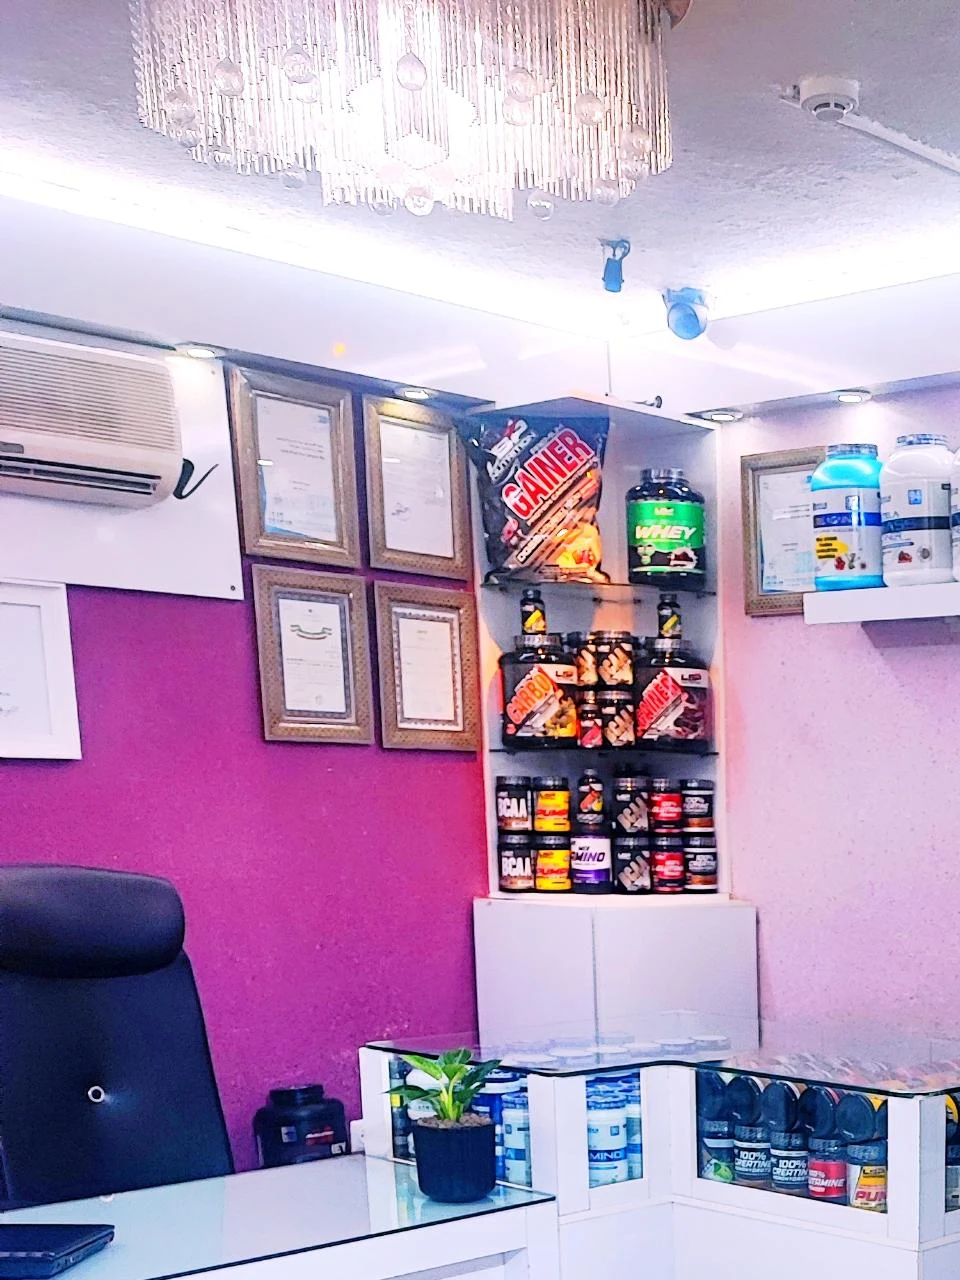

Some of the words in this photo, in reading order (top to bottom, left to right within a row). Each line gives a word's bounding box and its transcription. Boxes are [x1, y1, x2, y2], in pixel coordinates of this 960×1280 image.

[501, 427, 596, 520] GAINER
[635, 525, 697, 540] WHEY
[506, 671, 552, 725] CARBO
[502, 856, 532, 877] BCAA
[740, 1150, 767, 1160] 100%
[778, 1159, 807, 1169] 100%
